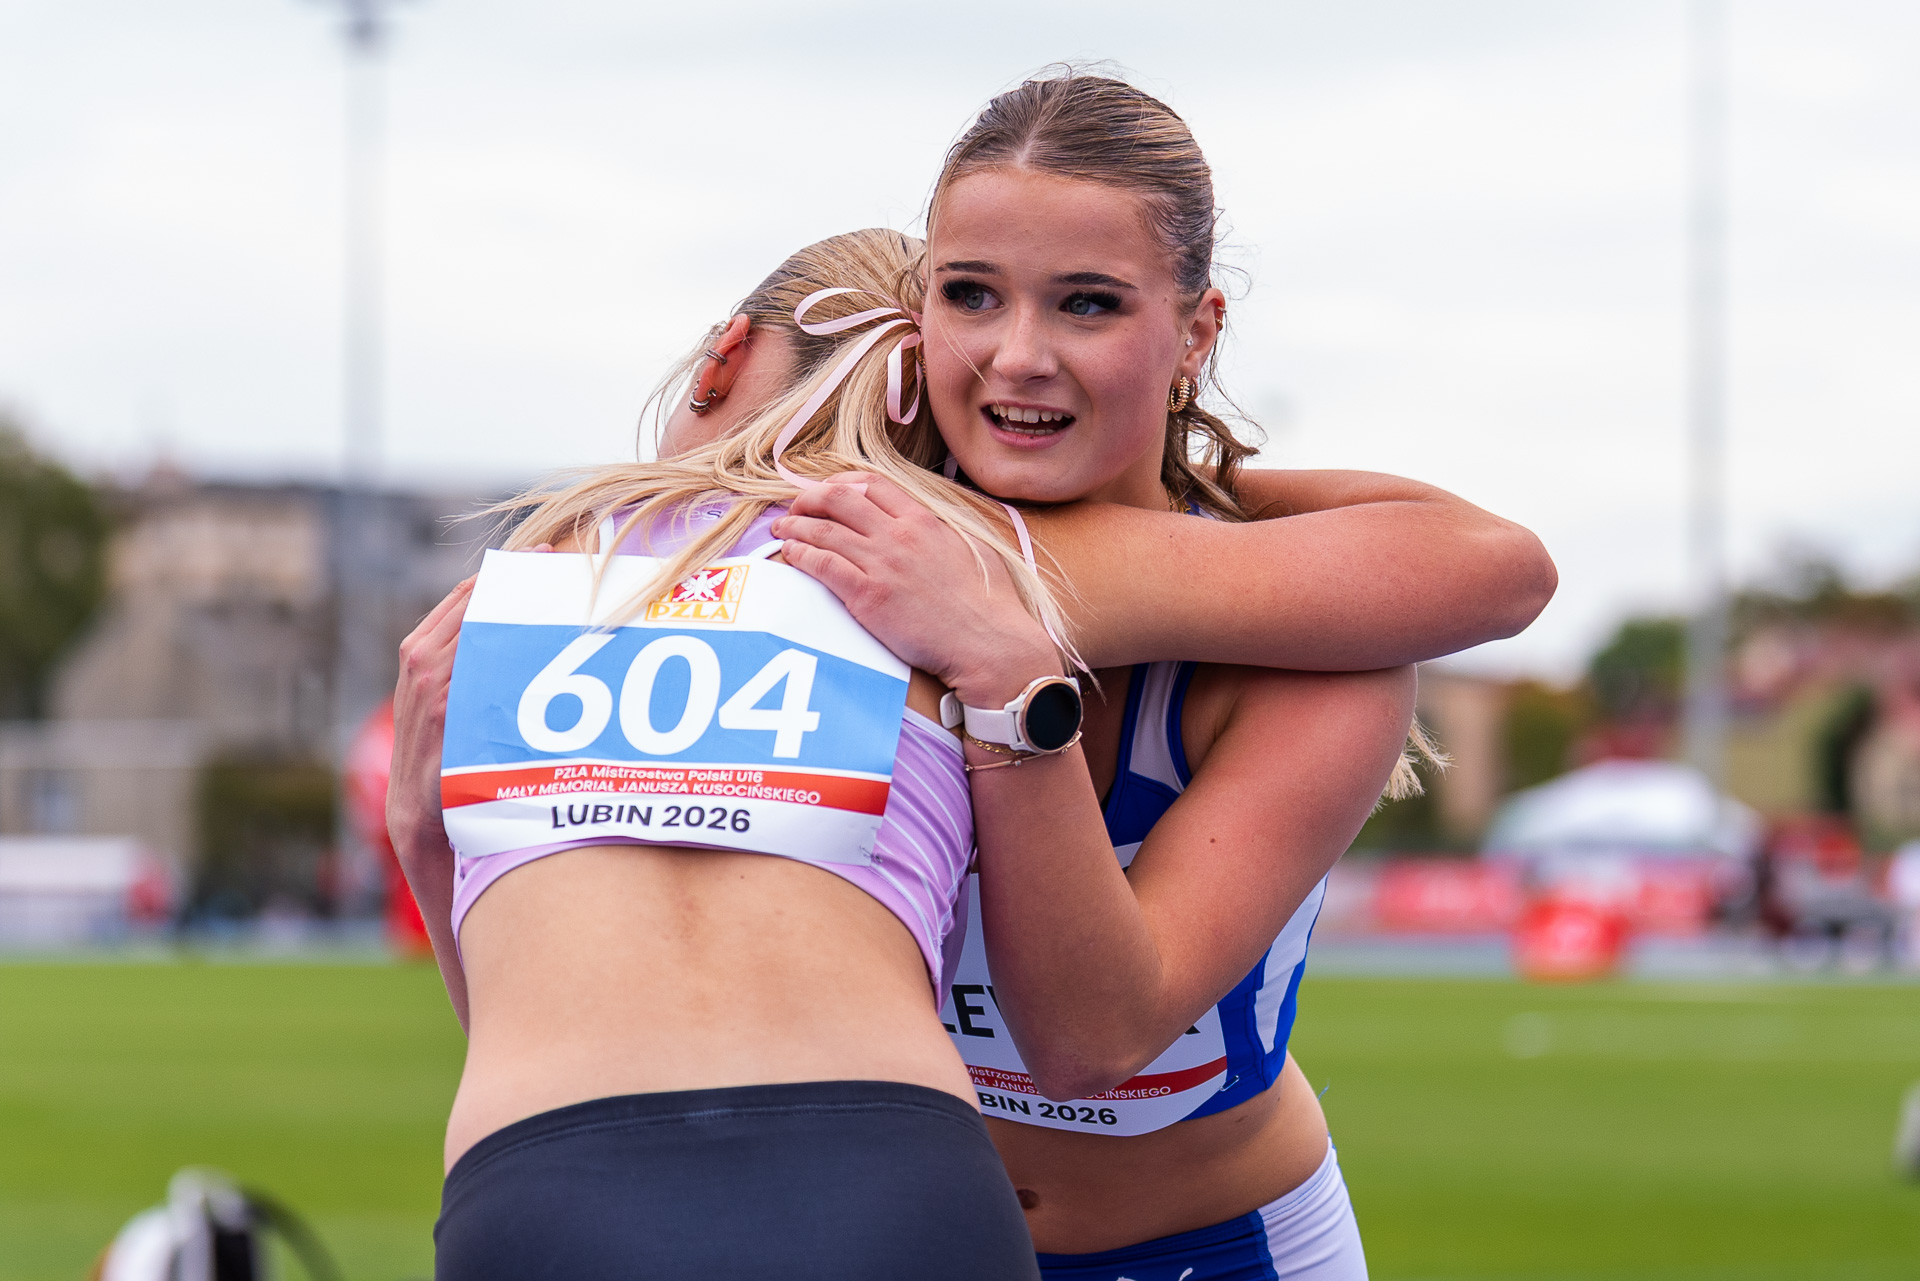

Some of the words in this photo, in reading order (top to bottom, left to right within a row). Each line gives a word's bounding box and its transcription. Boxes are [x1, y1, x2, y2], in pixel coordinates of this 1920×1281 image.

[650, 603, 730, 621] PZLA
[516, 633, 821, 760] 604
[553, 765, 588, 780] PZLA
[591, 765, 685, 781] Mistrzostwa
[688, 770, 733, 782] Polski
[736, 771, 764, 783] U16
[496, 784, 537, 800] MAŁY
[538, 779, 616, 796] MEMORIAŁ
[618, 780, 689, 794] JANUSZA
[692, 784, 821, 805] KUSOCIŃSKIEGO
[551, 803, 653, 830] LUBIN
[660, 804, 751, 834] 2026
[967, 1066, 1034, 1085] Mistrzostw
[992, 1079, 1041, 1095] JANUS
[976, 1091, 1032, 1116] BIN
[1037, 1101, 1118, 1126] 2026
